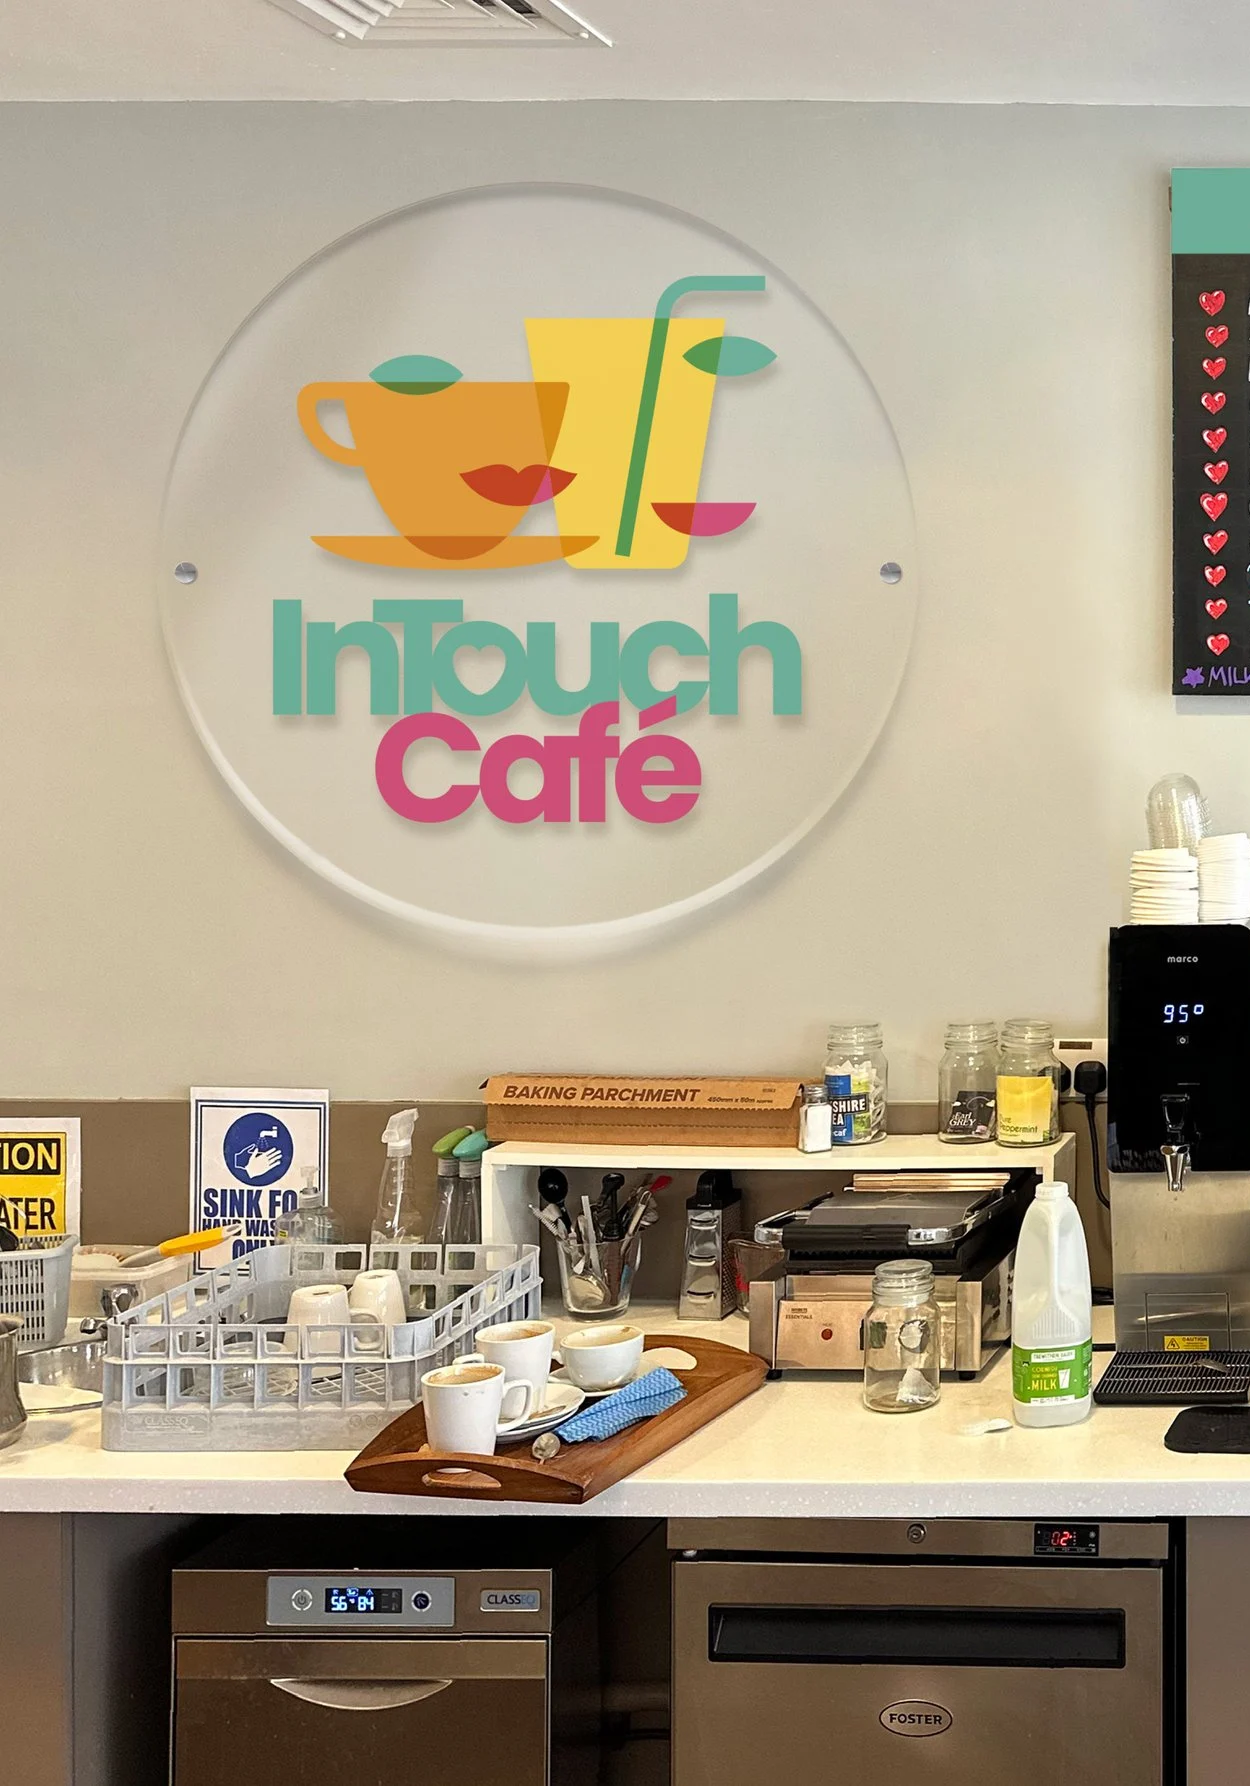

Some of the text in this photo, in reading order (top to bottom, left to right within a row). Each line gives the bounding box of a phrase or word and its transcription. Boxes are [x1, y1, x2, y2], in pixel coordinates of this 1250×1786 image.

[273, 593, 802, 716] InTouch
[375, 695, 702, 824] Café
[503, 1085, 700, 1102] BAKING PARCHMENT
[830, 1098, 867, 1113] SHIRE
[832, 1128, 847, 1136] caf
[0, 1142, 58, 1170] ION
[203, 1187, 298, 1218] SINK FO
[245, 1219, 276, 1237] WAS
[1031, 1379, 1057, 1391] MILK
[487, 1594, 537, 1605] CLASSEQ
[889, 1713, 942, 1725] FOSTER
